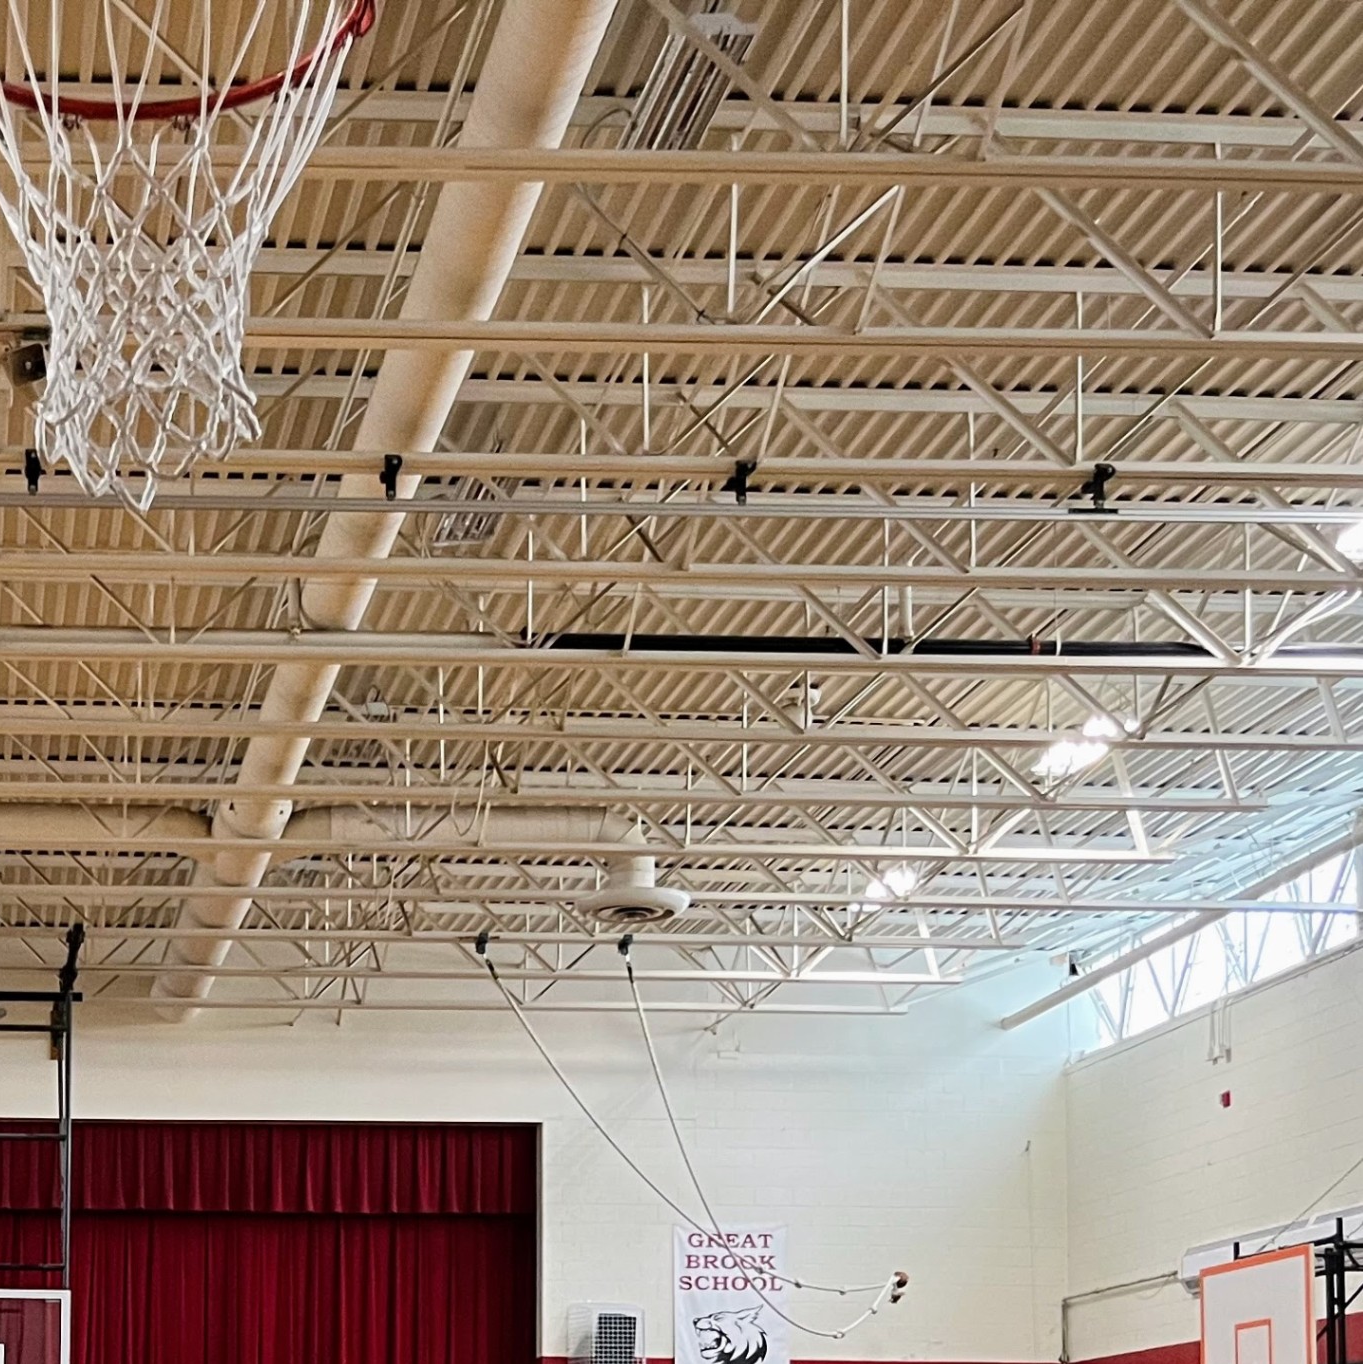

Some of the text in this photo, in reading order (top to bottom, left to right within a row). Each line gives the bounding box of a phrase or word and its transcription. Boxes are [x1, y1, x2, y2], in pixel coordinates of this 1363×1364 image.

[687, 1233, 773, 1249] GREAT
[684, 1254, 777, 1271] BROOK
[679, 1275, 784, 1292] SCHOOL
